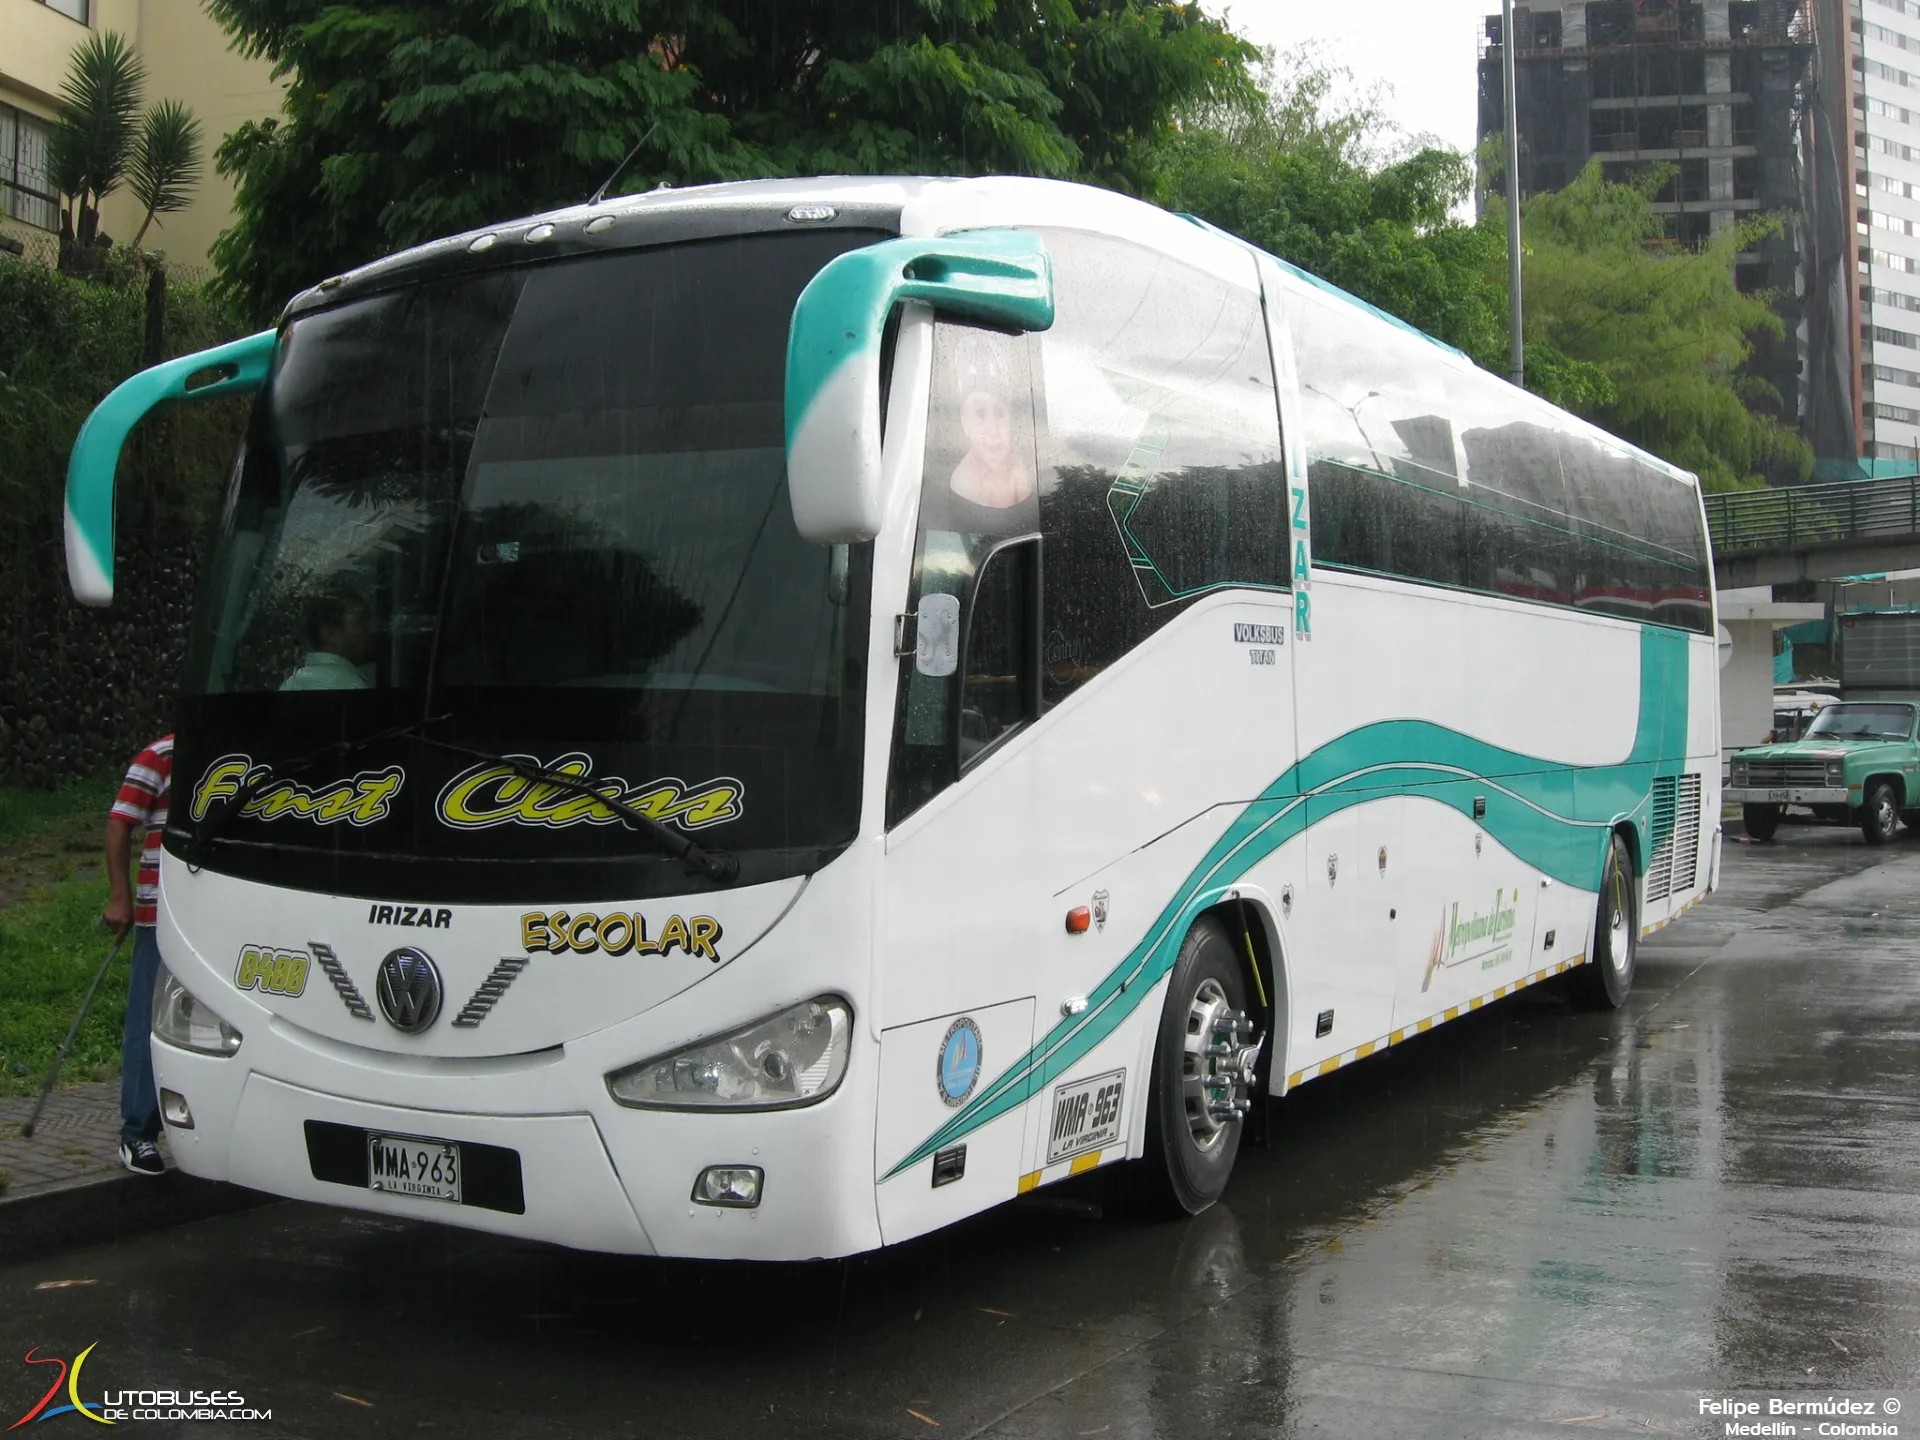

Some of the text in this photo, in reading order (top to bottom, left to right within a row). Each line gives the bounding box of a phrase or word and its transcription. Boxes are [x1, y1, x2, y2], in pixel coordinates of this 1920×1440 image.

[1234, 623, 1284, 644] VOLKSBUS
[1249, 649, 1275, 665] TITAN
[436, 752, 744, 829] Class
[369, 905, 452, 929] IRIZAR
[520, 911, 723, 963] ESCOLAR
[1062, 1128, 1108, 1151] LA VIRGINIA
[388, 1181, 441, 1196] LA VIRGINIA
